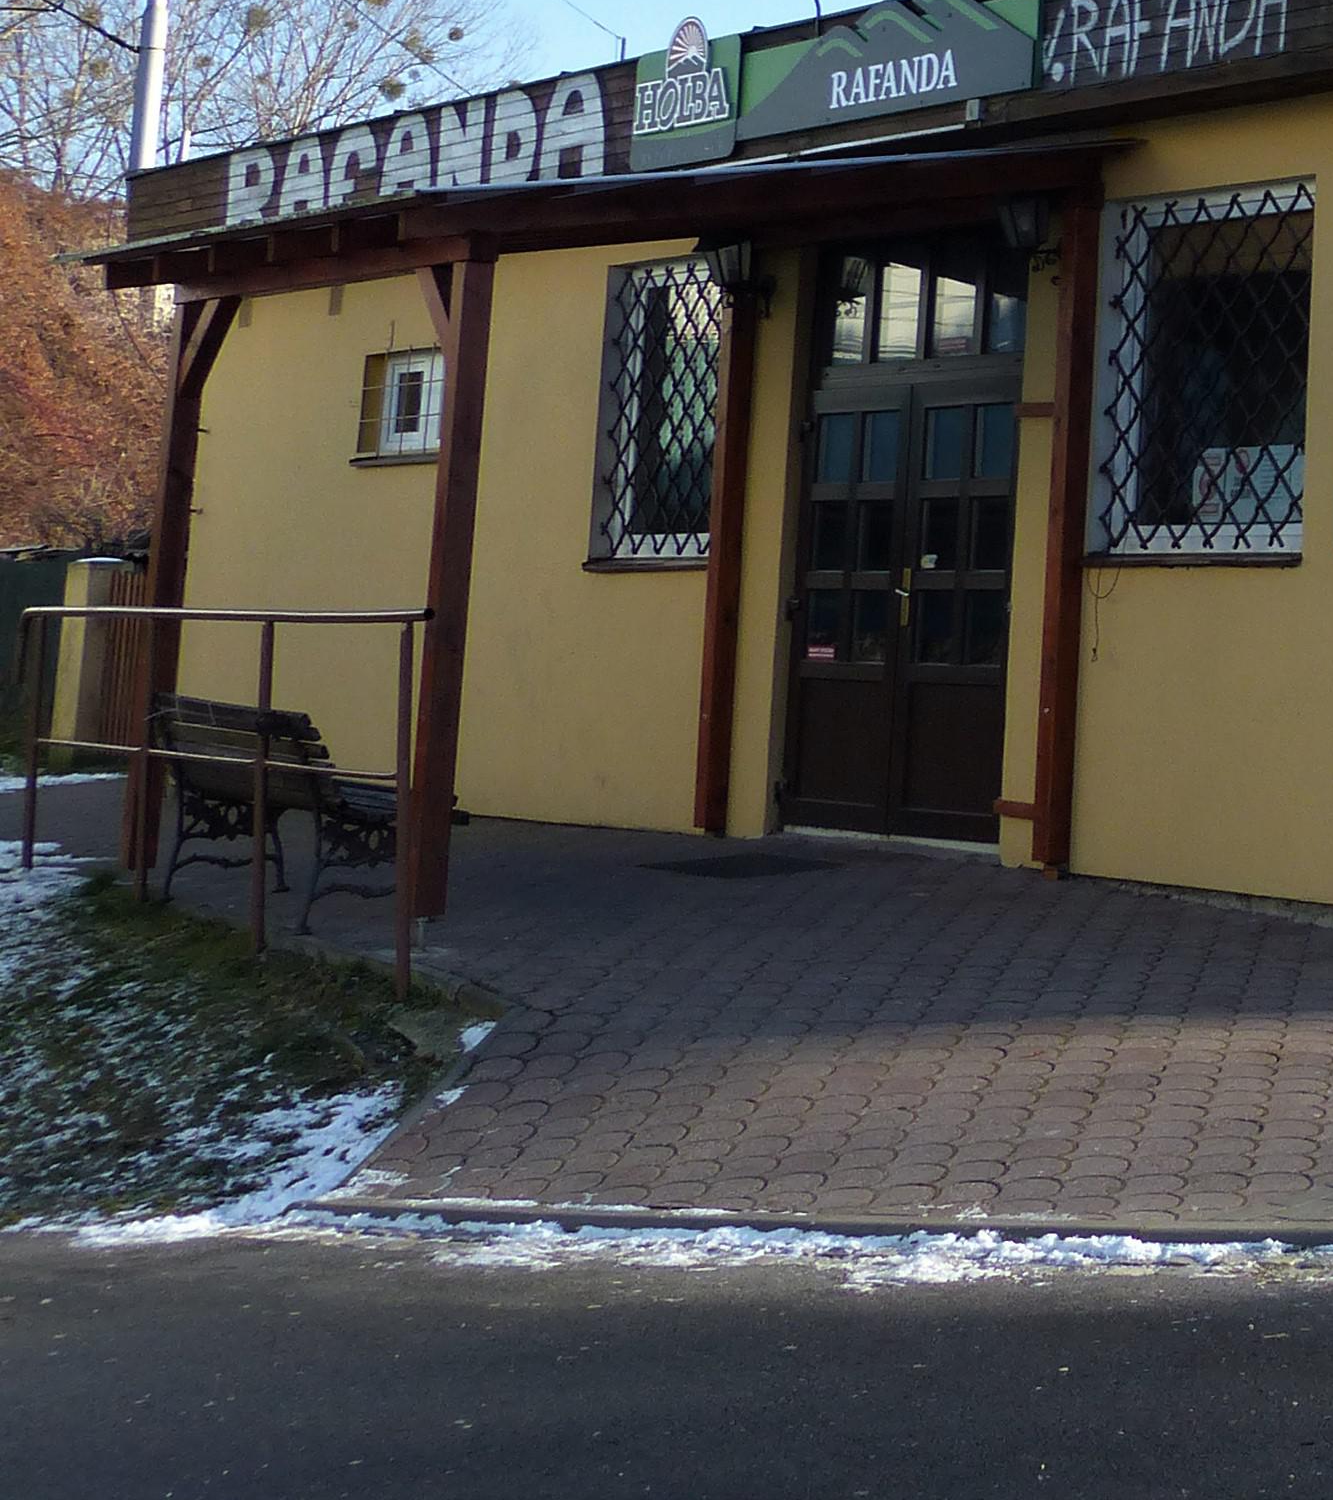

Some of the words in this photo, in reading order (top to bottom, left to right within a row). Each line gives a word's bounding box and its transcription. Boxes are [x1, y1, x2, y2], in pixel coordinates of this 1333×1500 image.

[633, 67, 730, 135] HOLBA
[829, 49, 958, 110] RAFANDA
[226, 73, 605, 227] RAFANDA
